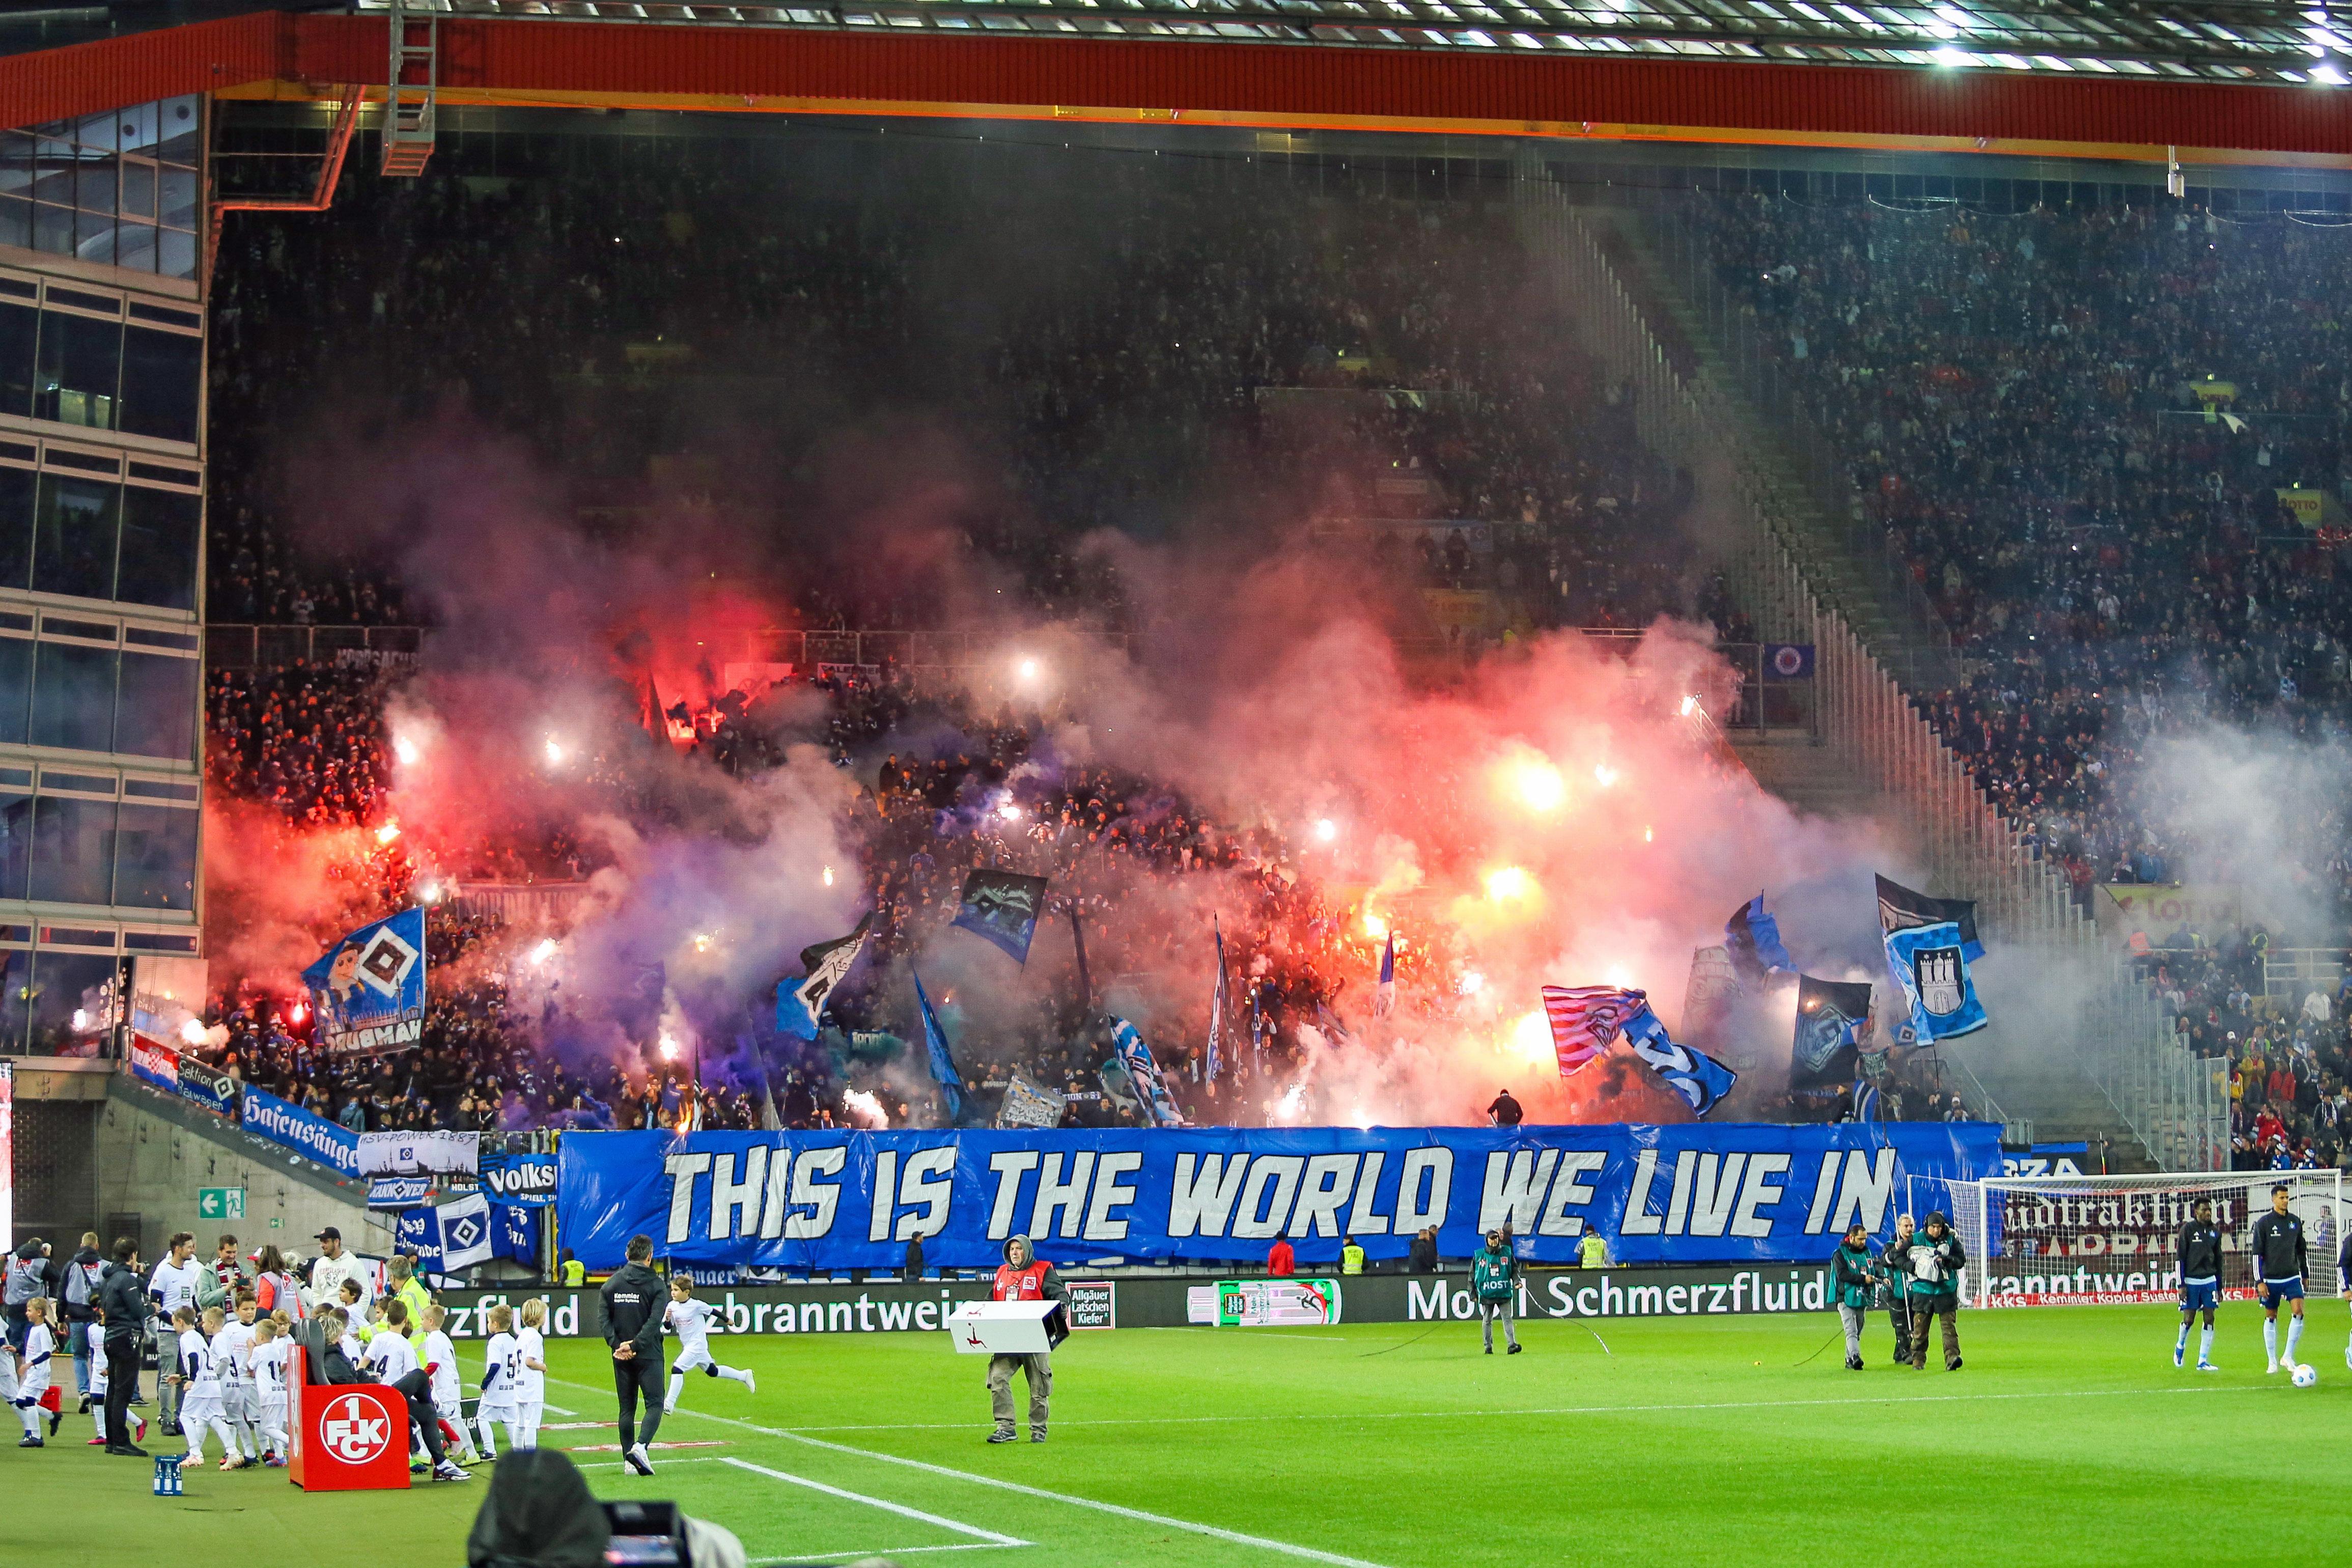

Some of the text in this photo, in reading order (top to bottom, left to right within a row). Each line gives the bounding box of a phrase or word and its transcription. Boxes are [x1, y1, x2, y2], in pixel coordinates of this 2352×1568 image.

[2289, 500, 2317, 510] OTTO
[179, 1059, 212, 1087] Sektion
[243, 1095, 358, 1170] Hafensänge
[440, 1131, 479, 1145] 1887
[487, 1162, 558, 1194] Volks
[664, 1144, 1898, 1244] THIS IS THE WORLD WE LIVE IN
[2004, 1192, 2233, 1233] üdtraktion
[1482, 1280, 1508, 1291] HOST
[1072, 1289, 1109, 1302] Allgäuer
[1407, 1271, 1825, 1321] Mol Schmerzfluid
[2039, 1294, 2093, 1304] Kemmler
[707, 1289, 963, 1334] zbranntwei
[1072, 1302, 1109, 1313] Latschen
[1078, 1313, 1104, 1324] Kiefer
[377, 1354, 389, 1377] 4
[463, 1416, 477, 1429] LIGA
